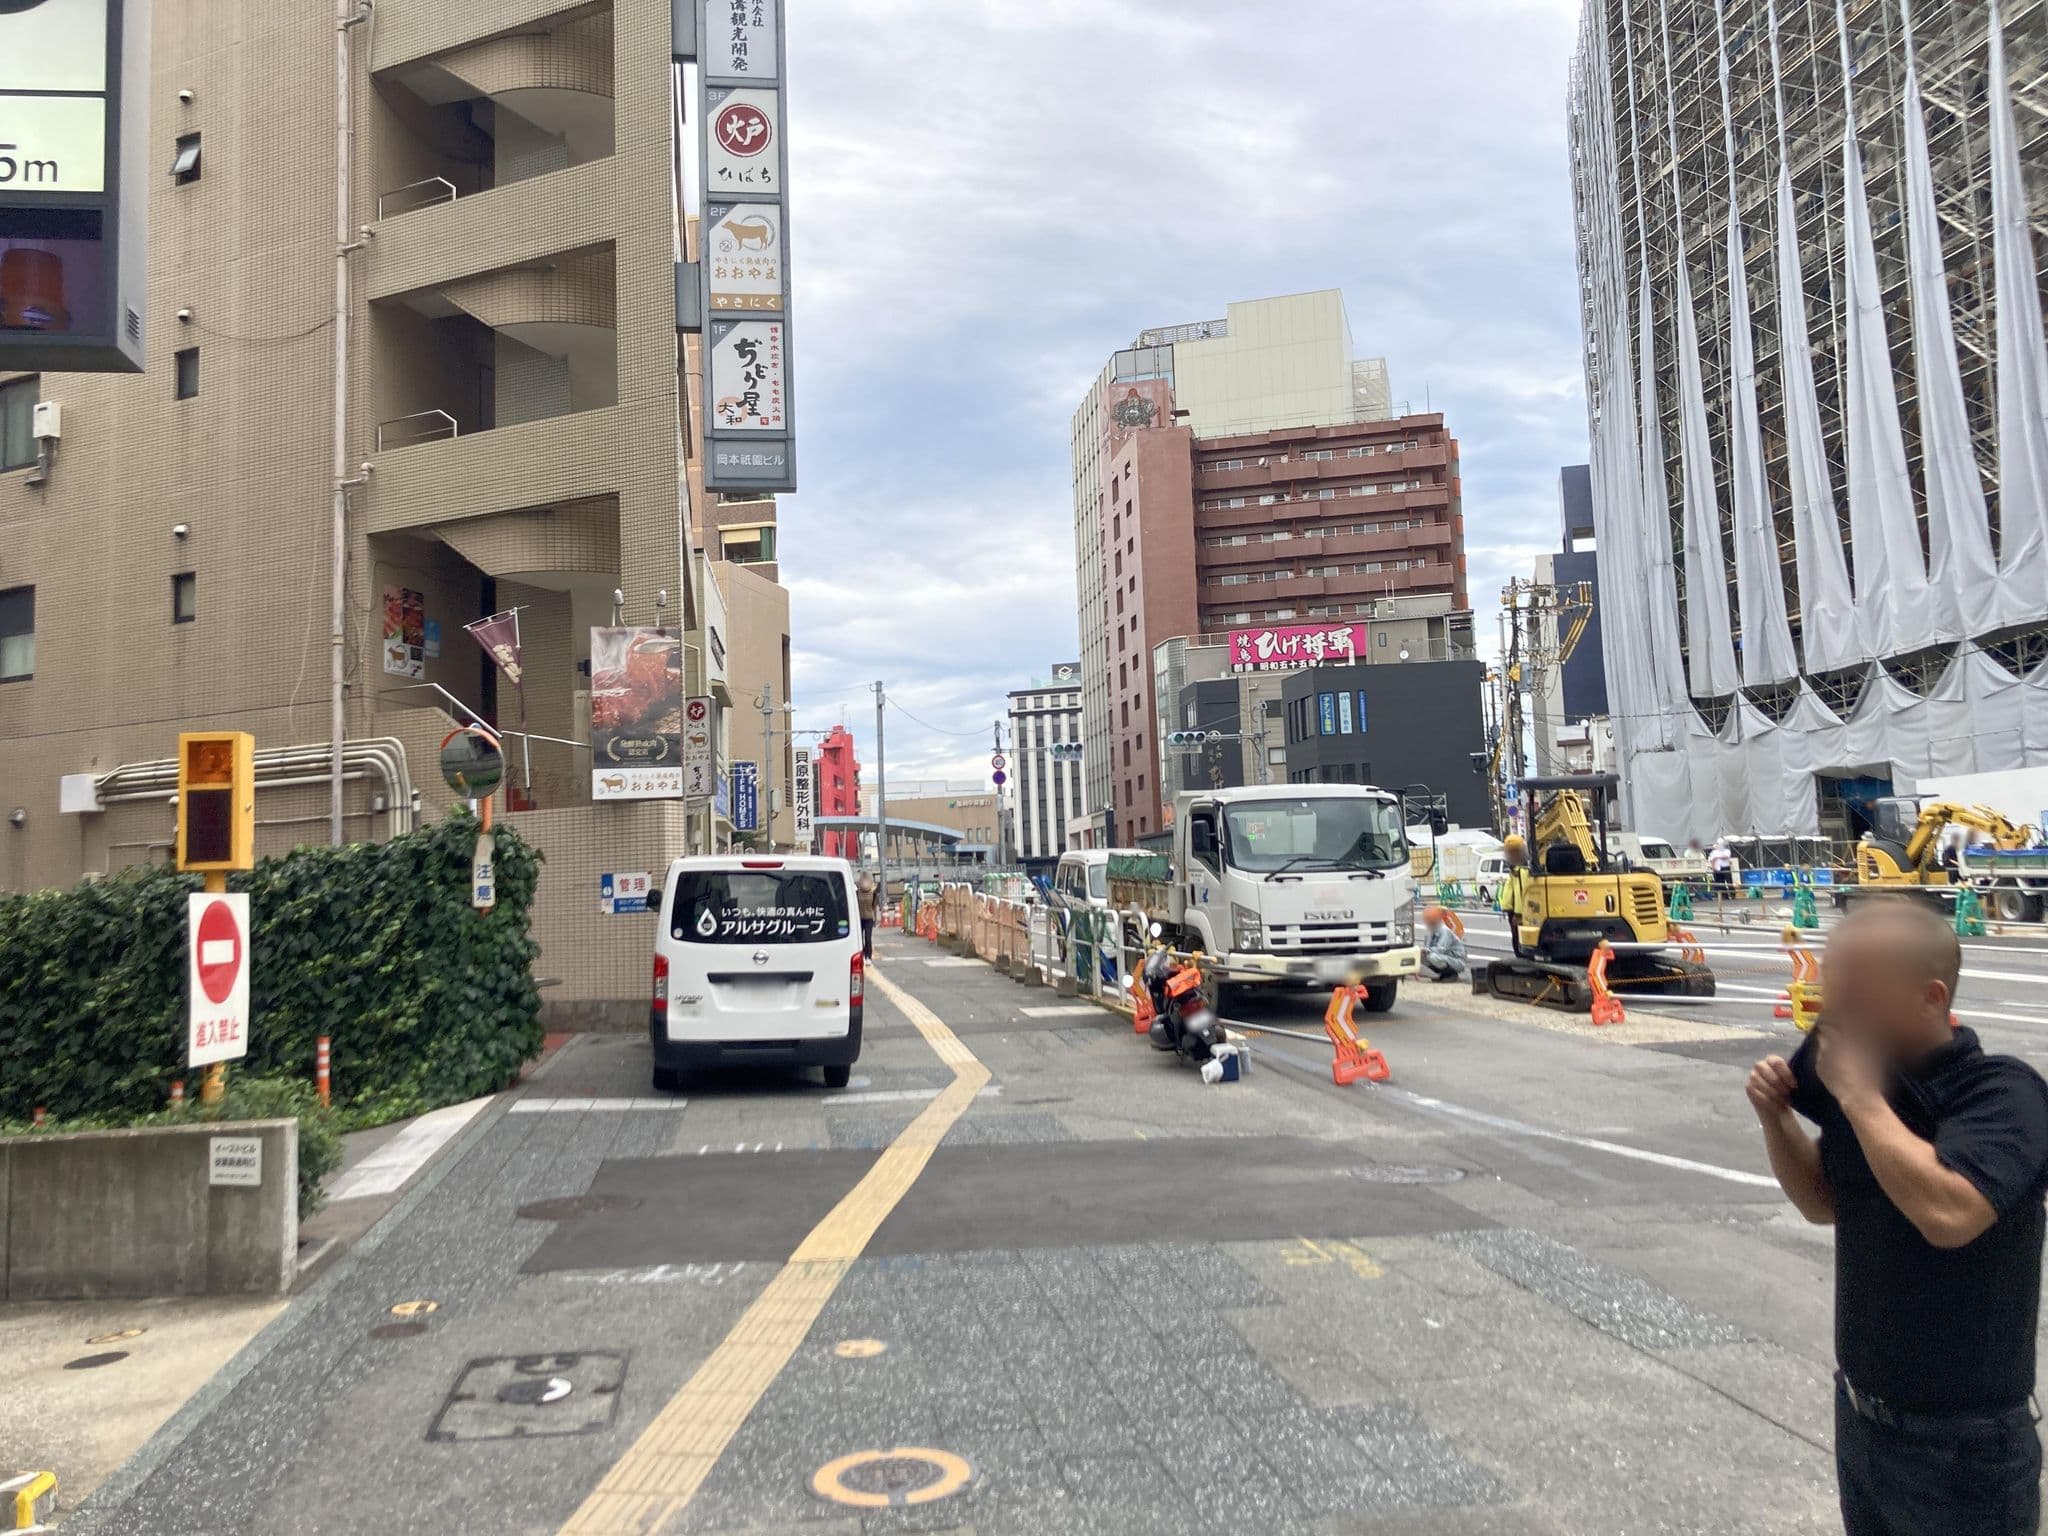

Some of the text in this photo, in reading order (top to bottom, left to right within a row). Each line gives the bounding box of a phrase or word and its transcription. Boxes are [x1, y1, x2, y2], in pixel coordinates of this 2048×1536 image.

[708, 91, 726, 101] 3F
[718, 167, 771, 183] ひばち
[710, 207, 727, 217] 2F
[714, 266, 777, 280] おおやま
[716, 296, 776, 309] やきにく
[713, 325, 727, 334] 1F
[733, 338, 769, 417] ぢどり屋
[718, 402, 743, 426] 大和
[1237, 634, 1251, 662] 焼鳥
[1254, 627, 1353, 660] ひげ将軍
[631, 780, 680, 792] おおやま
[795, 751, 810, 830] 貝原整形外科
[476, 864, 492, 900] 注意
[1304, 910, 1354, 920] ISUZU
[721, 919, 825, 935] アルサグループ
[196, 1016, 241, 1047] 進入禁止
